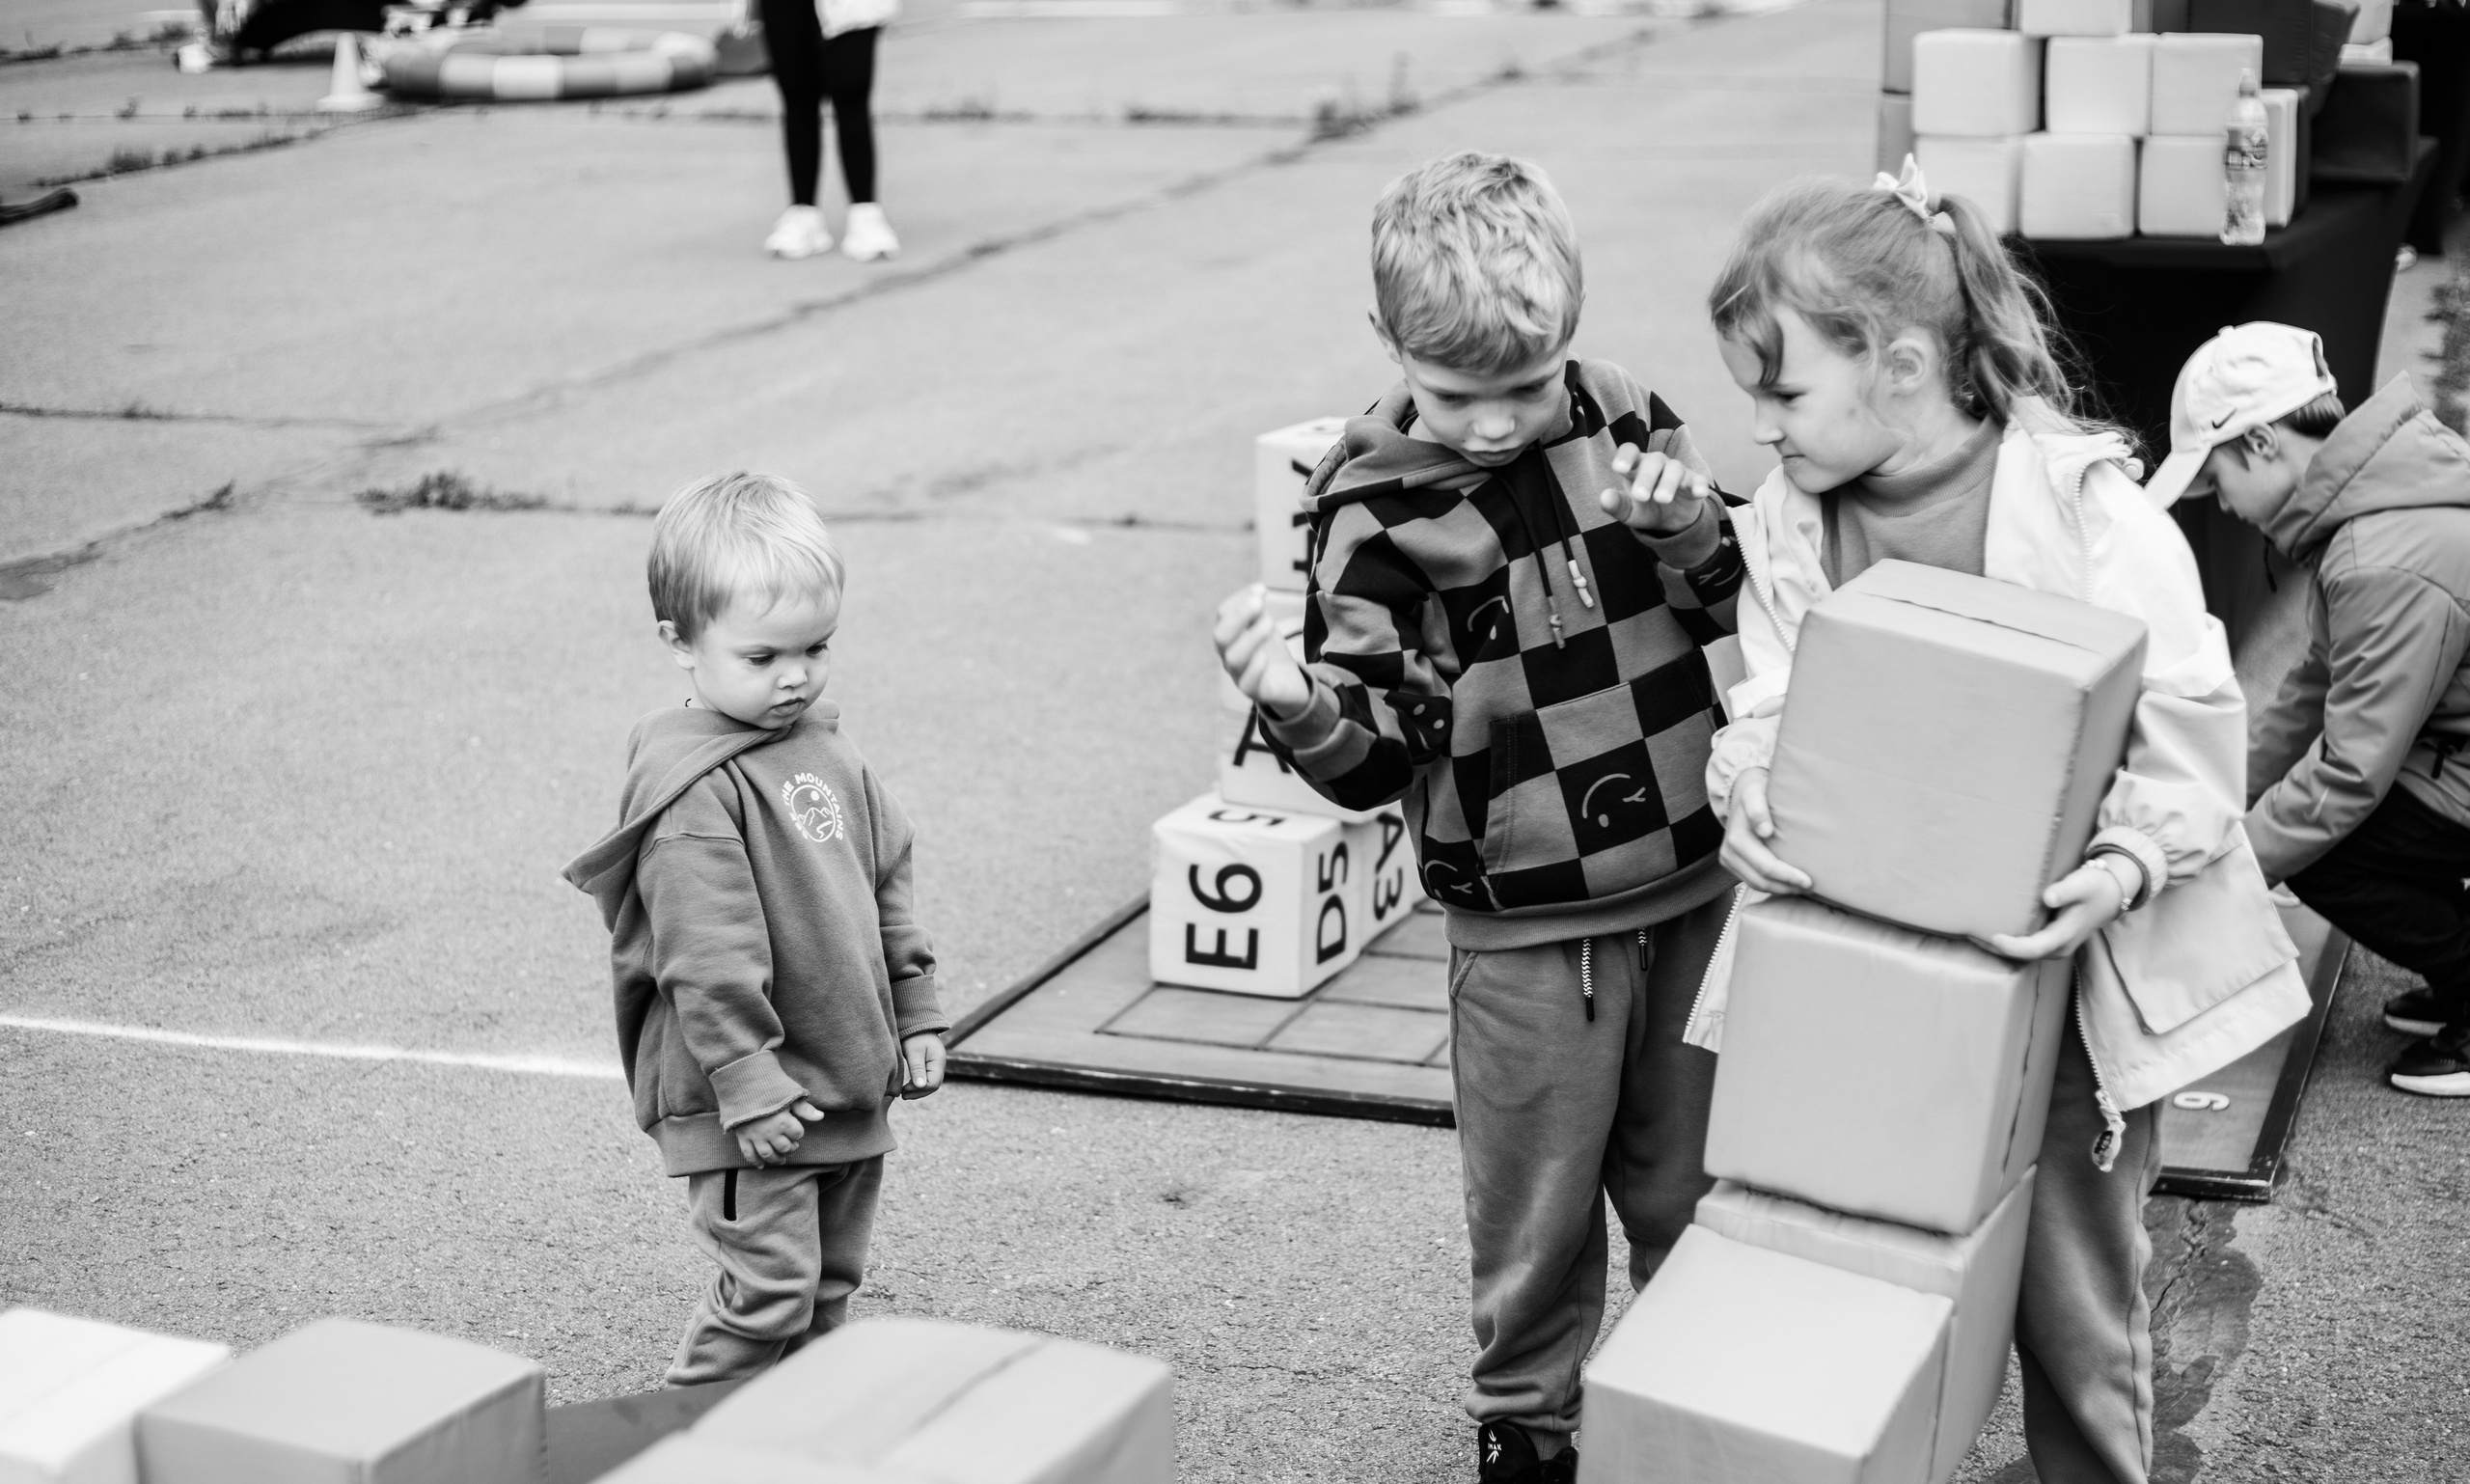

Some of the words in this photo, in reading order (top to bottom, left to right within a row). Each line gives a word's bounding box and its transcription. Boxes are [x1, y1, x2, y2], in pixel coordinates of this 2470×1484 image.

[794, 772, 844, 840] MOUNTAINS
[1185, 862, 1263, 971] E6
[1316, 840, 1349, 965] D5
[1374, 811, 1405, 921] A3
